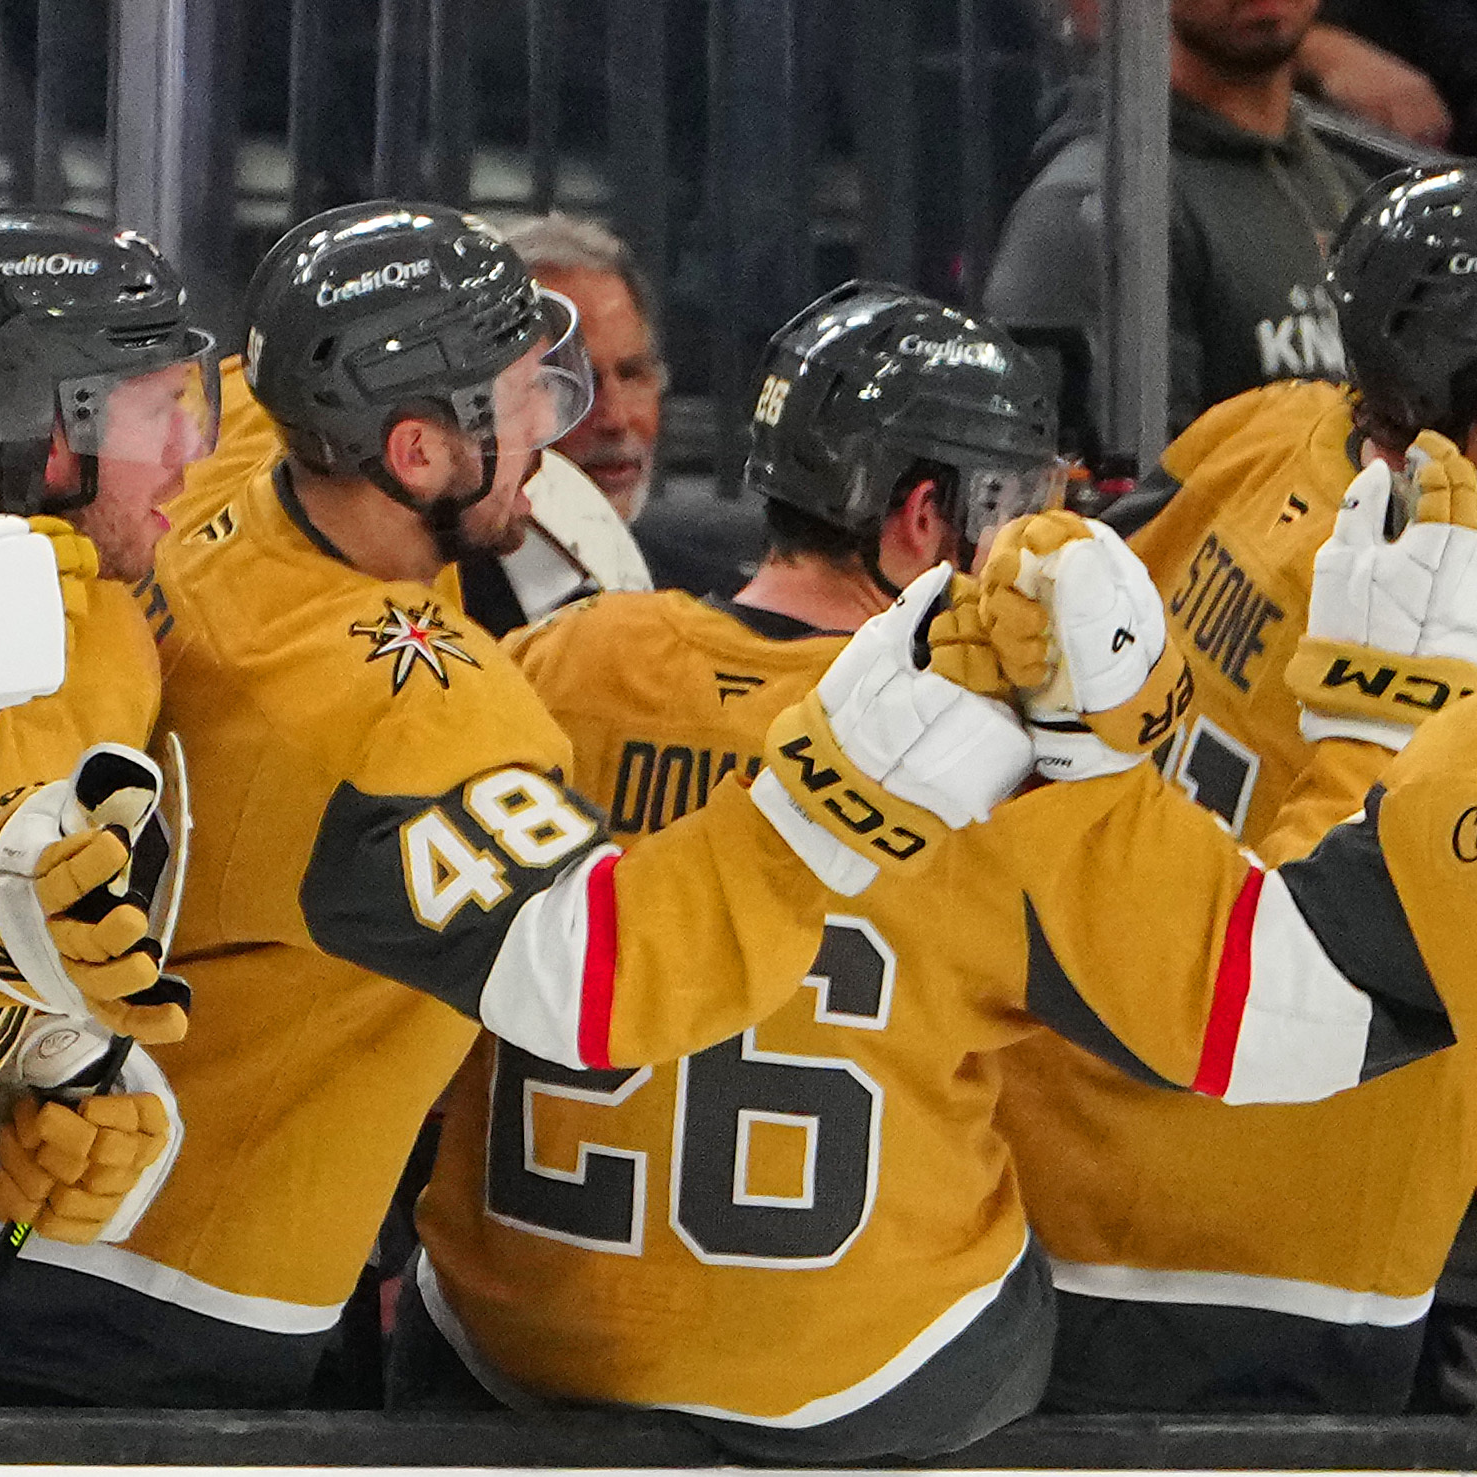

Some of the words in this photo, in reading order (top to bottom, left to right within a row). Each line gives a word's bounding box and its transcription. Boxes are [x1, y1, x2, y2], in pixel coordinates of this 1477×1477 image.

[1170, 531, 1285, 694] STONE
[1321, 657, 1473, 711] CM
[399, 766, 599, 932] 48
[778, 735, 927, 861] CCM
[485, 913, 898, 1270] 26
